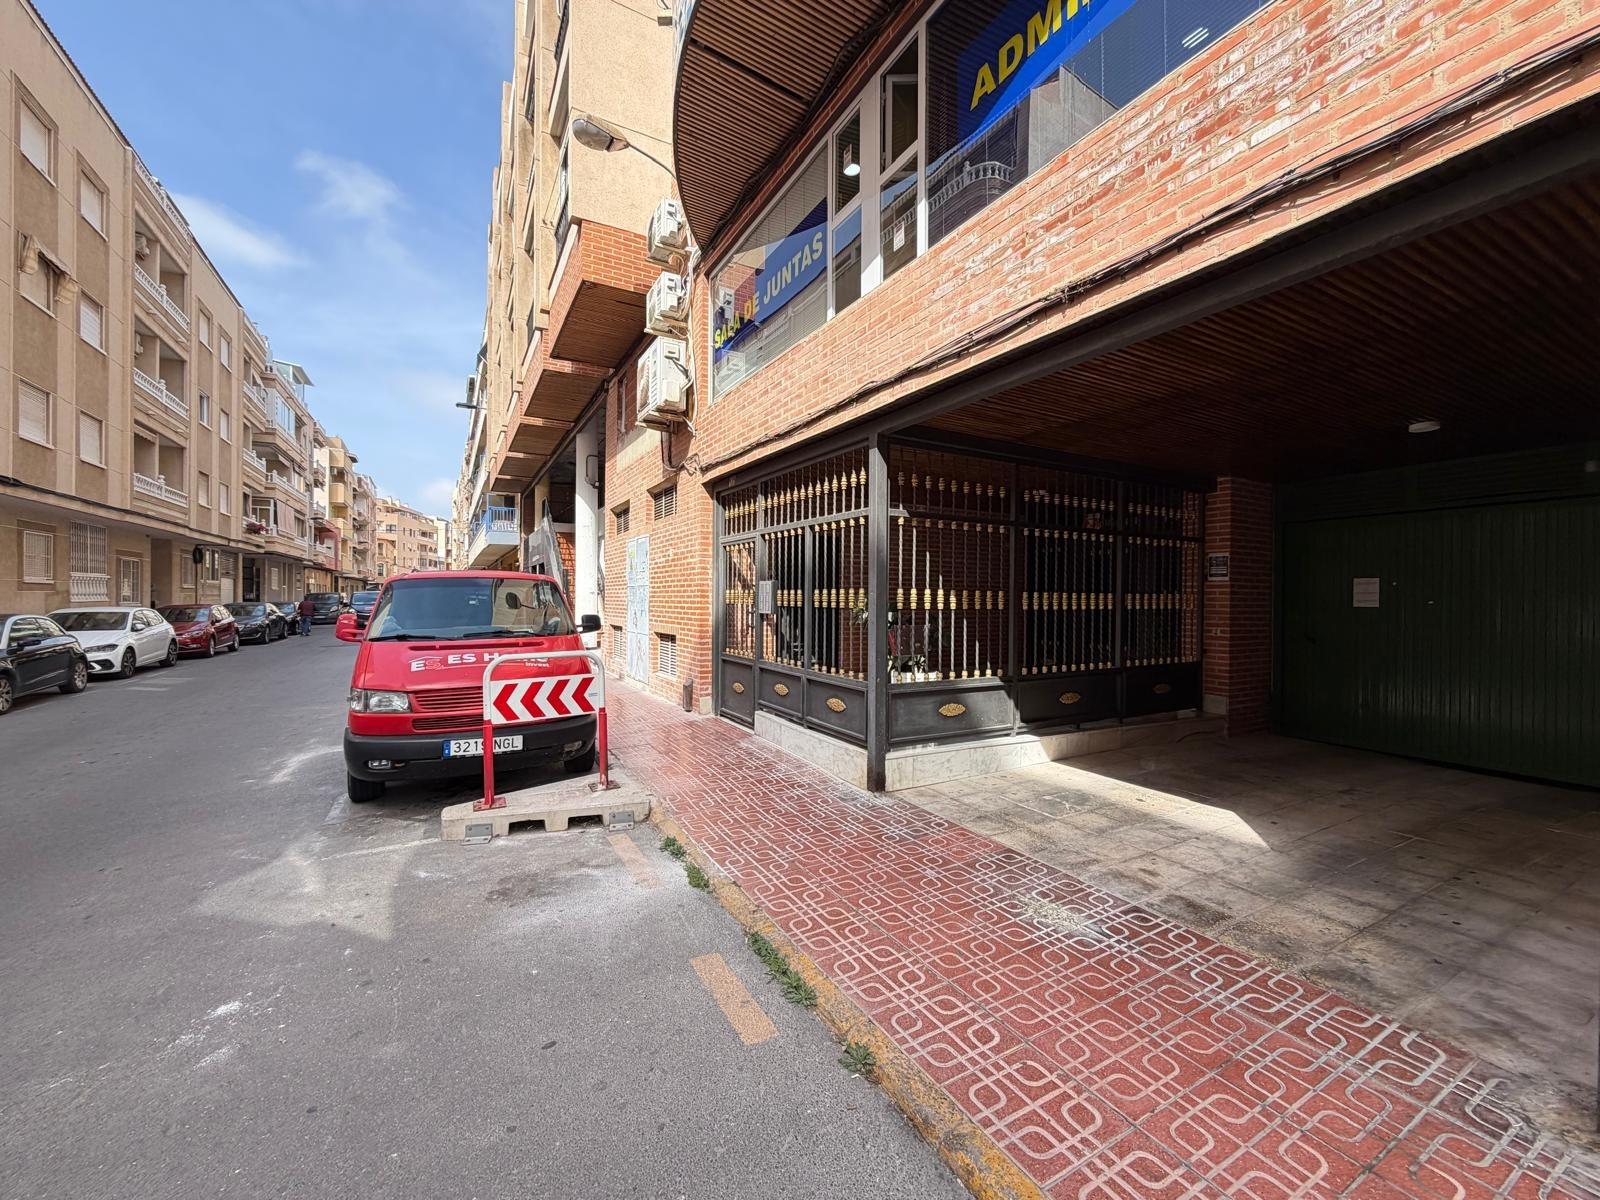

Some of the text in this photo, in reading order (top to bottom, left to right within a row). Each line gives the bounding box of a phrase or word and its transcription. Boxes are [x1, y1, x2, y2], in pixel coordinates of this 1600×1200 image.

[714, 231, 823, 349] SALA DE JUNTAS
[447, 653, 477, 664] ES
[454, 738, 518, 753] 321 NGL
